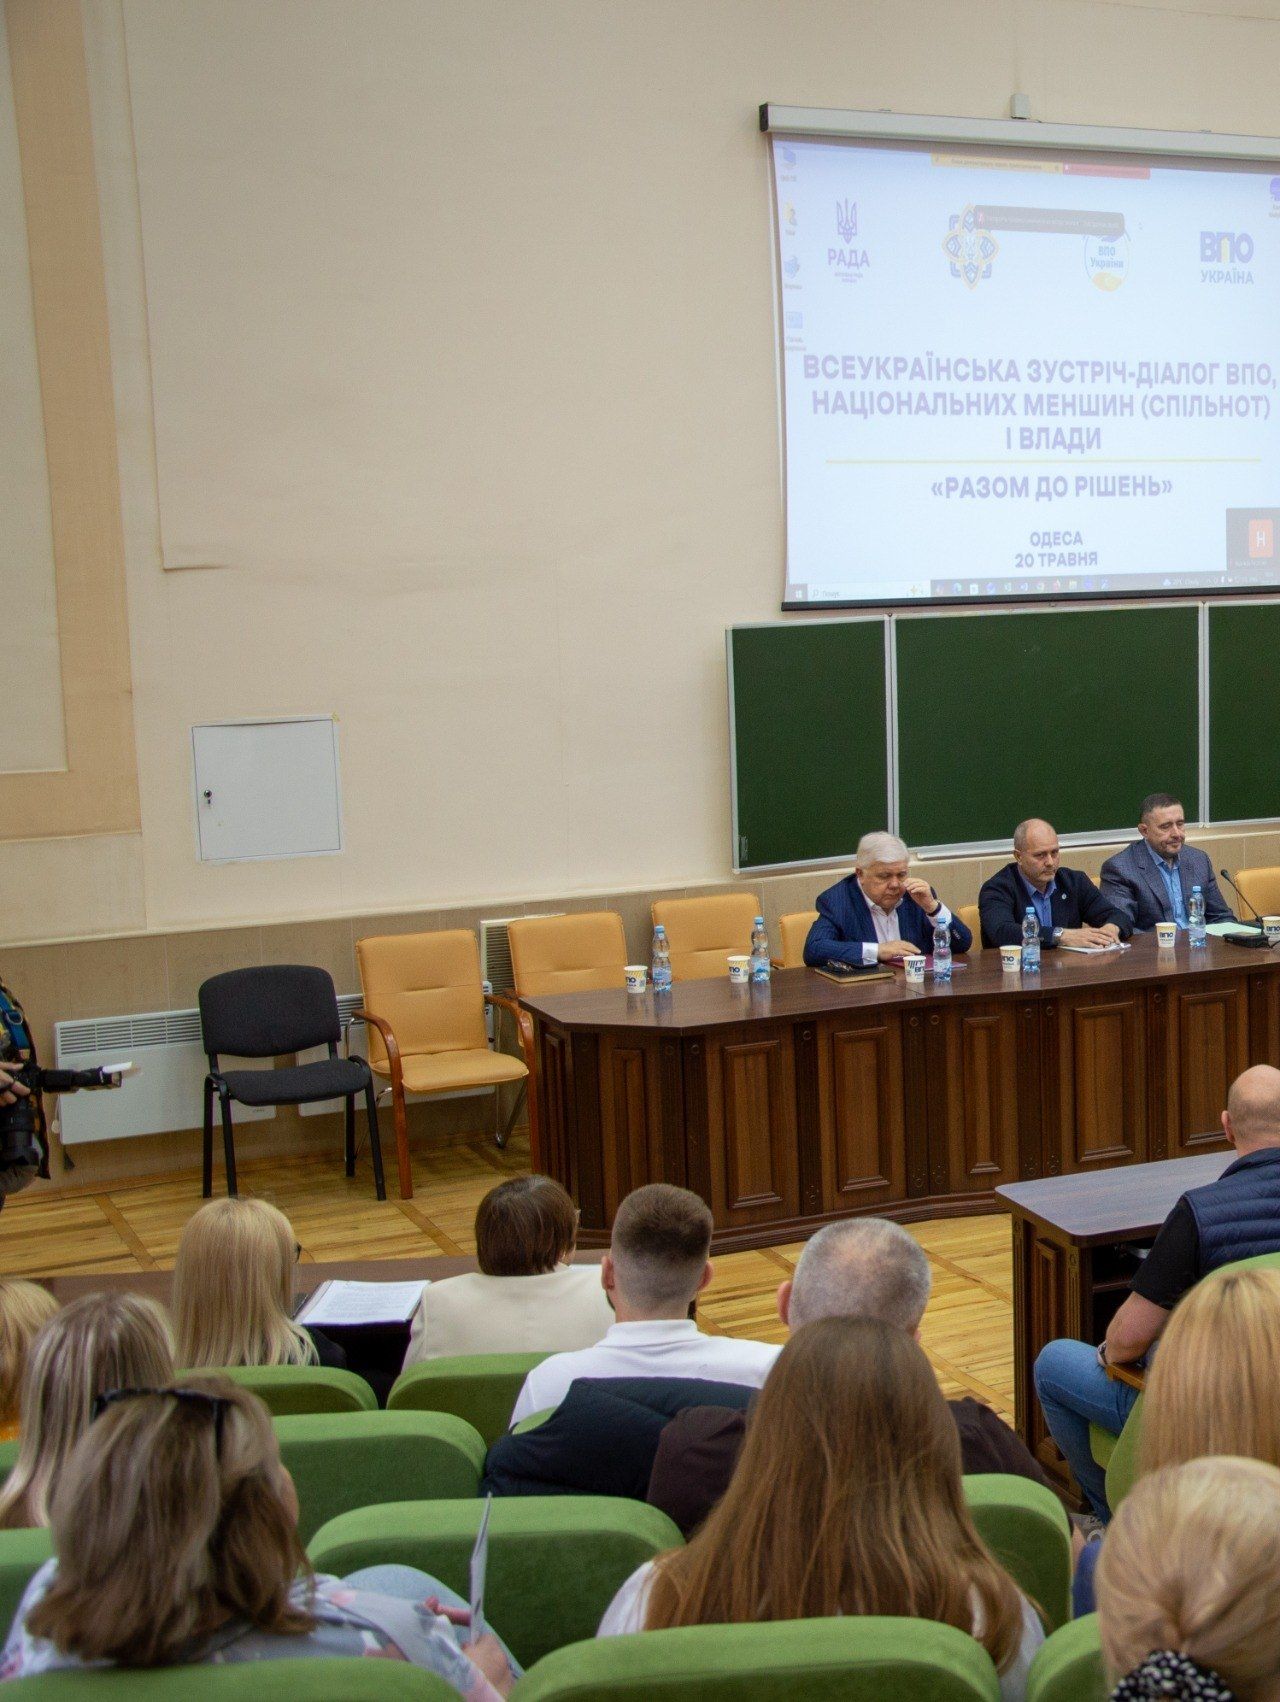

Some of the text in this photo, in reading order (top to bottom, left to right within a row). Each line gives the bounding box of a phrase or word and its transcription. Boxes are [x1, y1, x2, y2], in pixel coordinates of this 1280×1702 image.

[828, 248, 870, 269] РАДА
[1098, 246, 1116, 256] ВПО
[1200, 231, 1254, 263] ВПО
[1200, 267, 1254, 284] УКРАЇНА
[803, 351, 1277, 389] ВСЕУКРАЇНСЬКА ЗУСТРІЧ-ДІАЛОГ ВПО,
[812, 390, 1270, 420] НАЦІОНАЛЬНИХ МЕНШИН (СПІЛЬНОТ)
[1006, 427, 1102, 453] І ВЛАДИ
[932, 475, 1172, 501] «РАЗОМ ДО РІШЕНЬ»
[1030, 531, 1083, 548] ОДЕСА
[1015, 551, 1098, 569] 20 ТРАВНЯ
